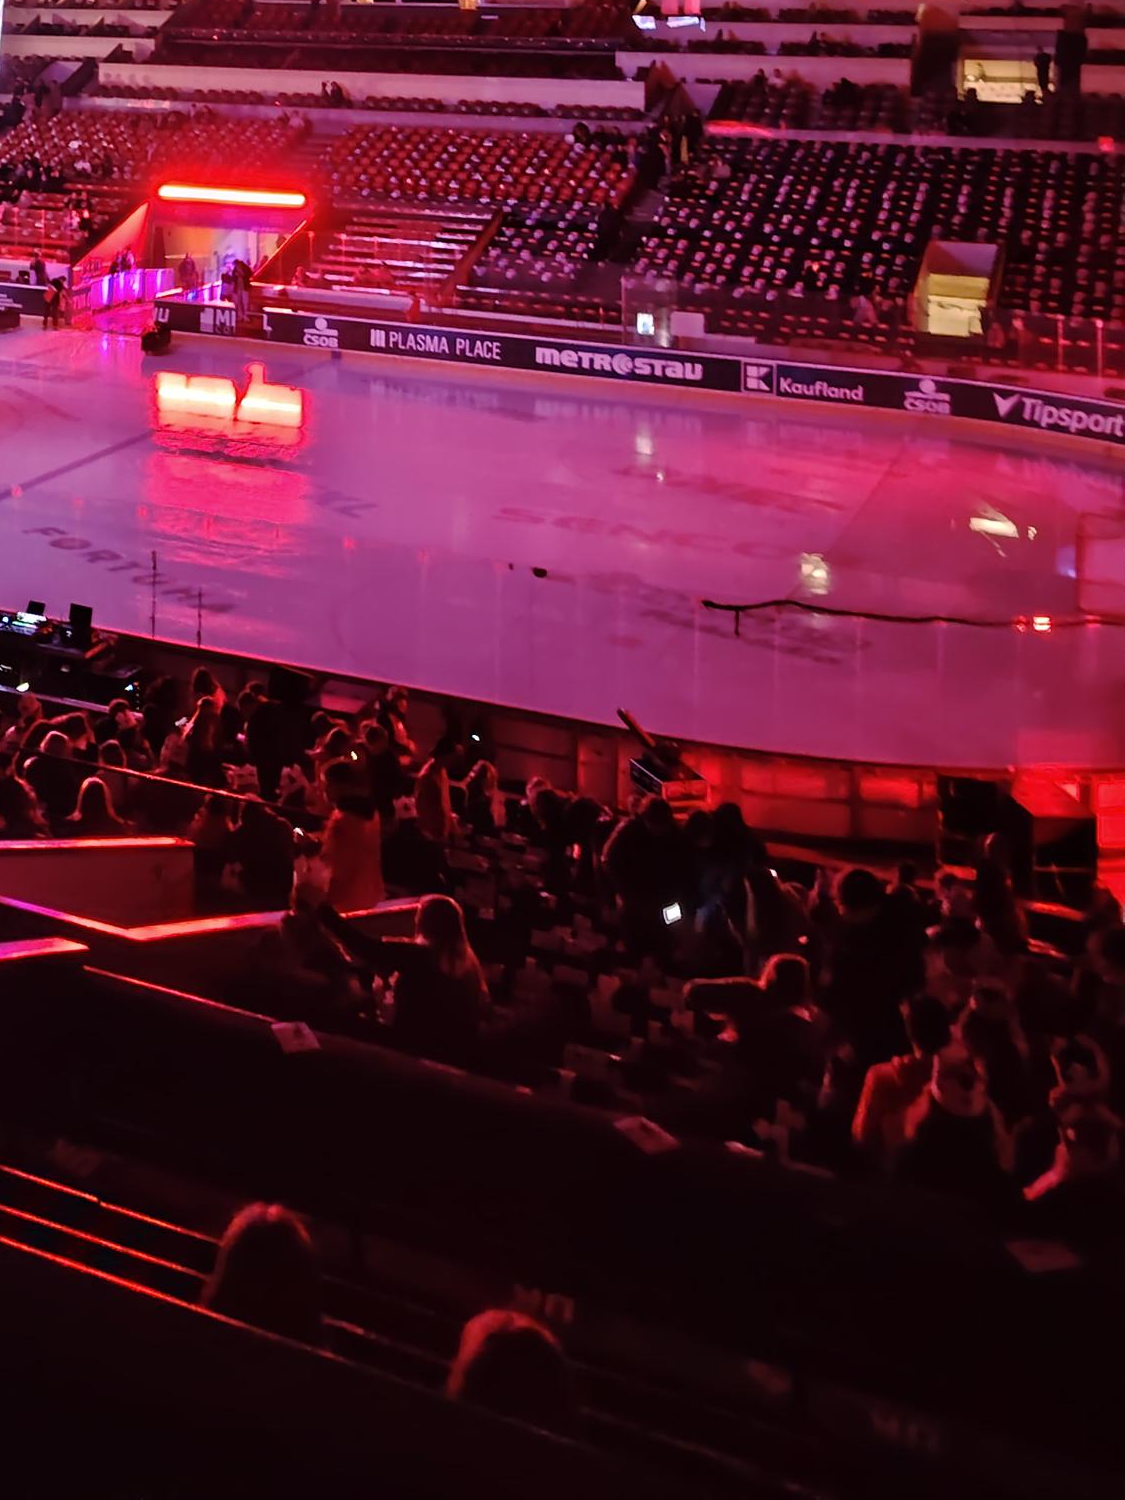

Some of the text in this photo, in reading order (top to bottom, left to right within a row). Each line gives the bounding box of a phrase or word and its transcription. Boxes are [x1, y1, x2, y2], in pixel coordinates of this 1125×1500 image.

[388, 330, 502, 361] PLASMA PLACE
[778, 376, 865, 401] Kaufland
[1020, 396, 1125, 438] Tipsport
